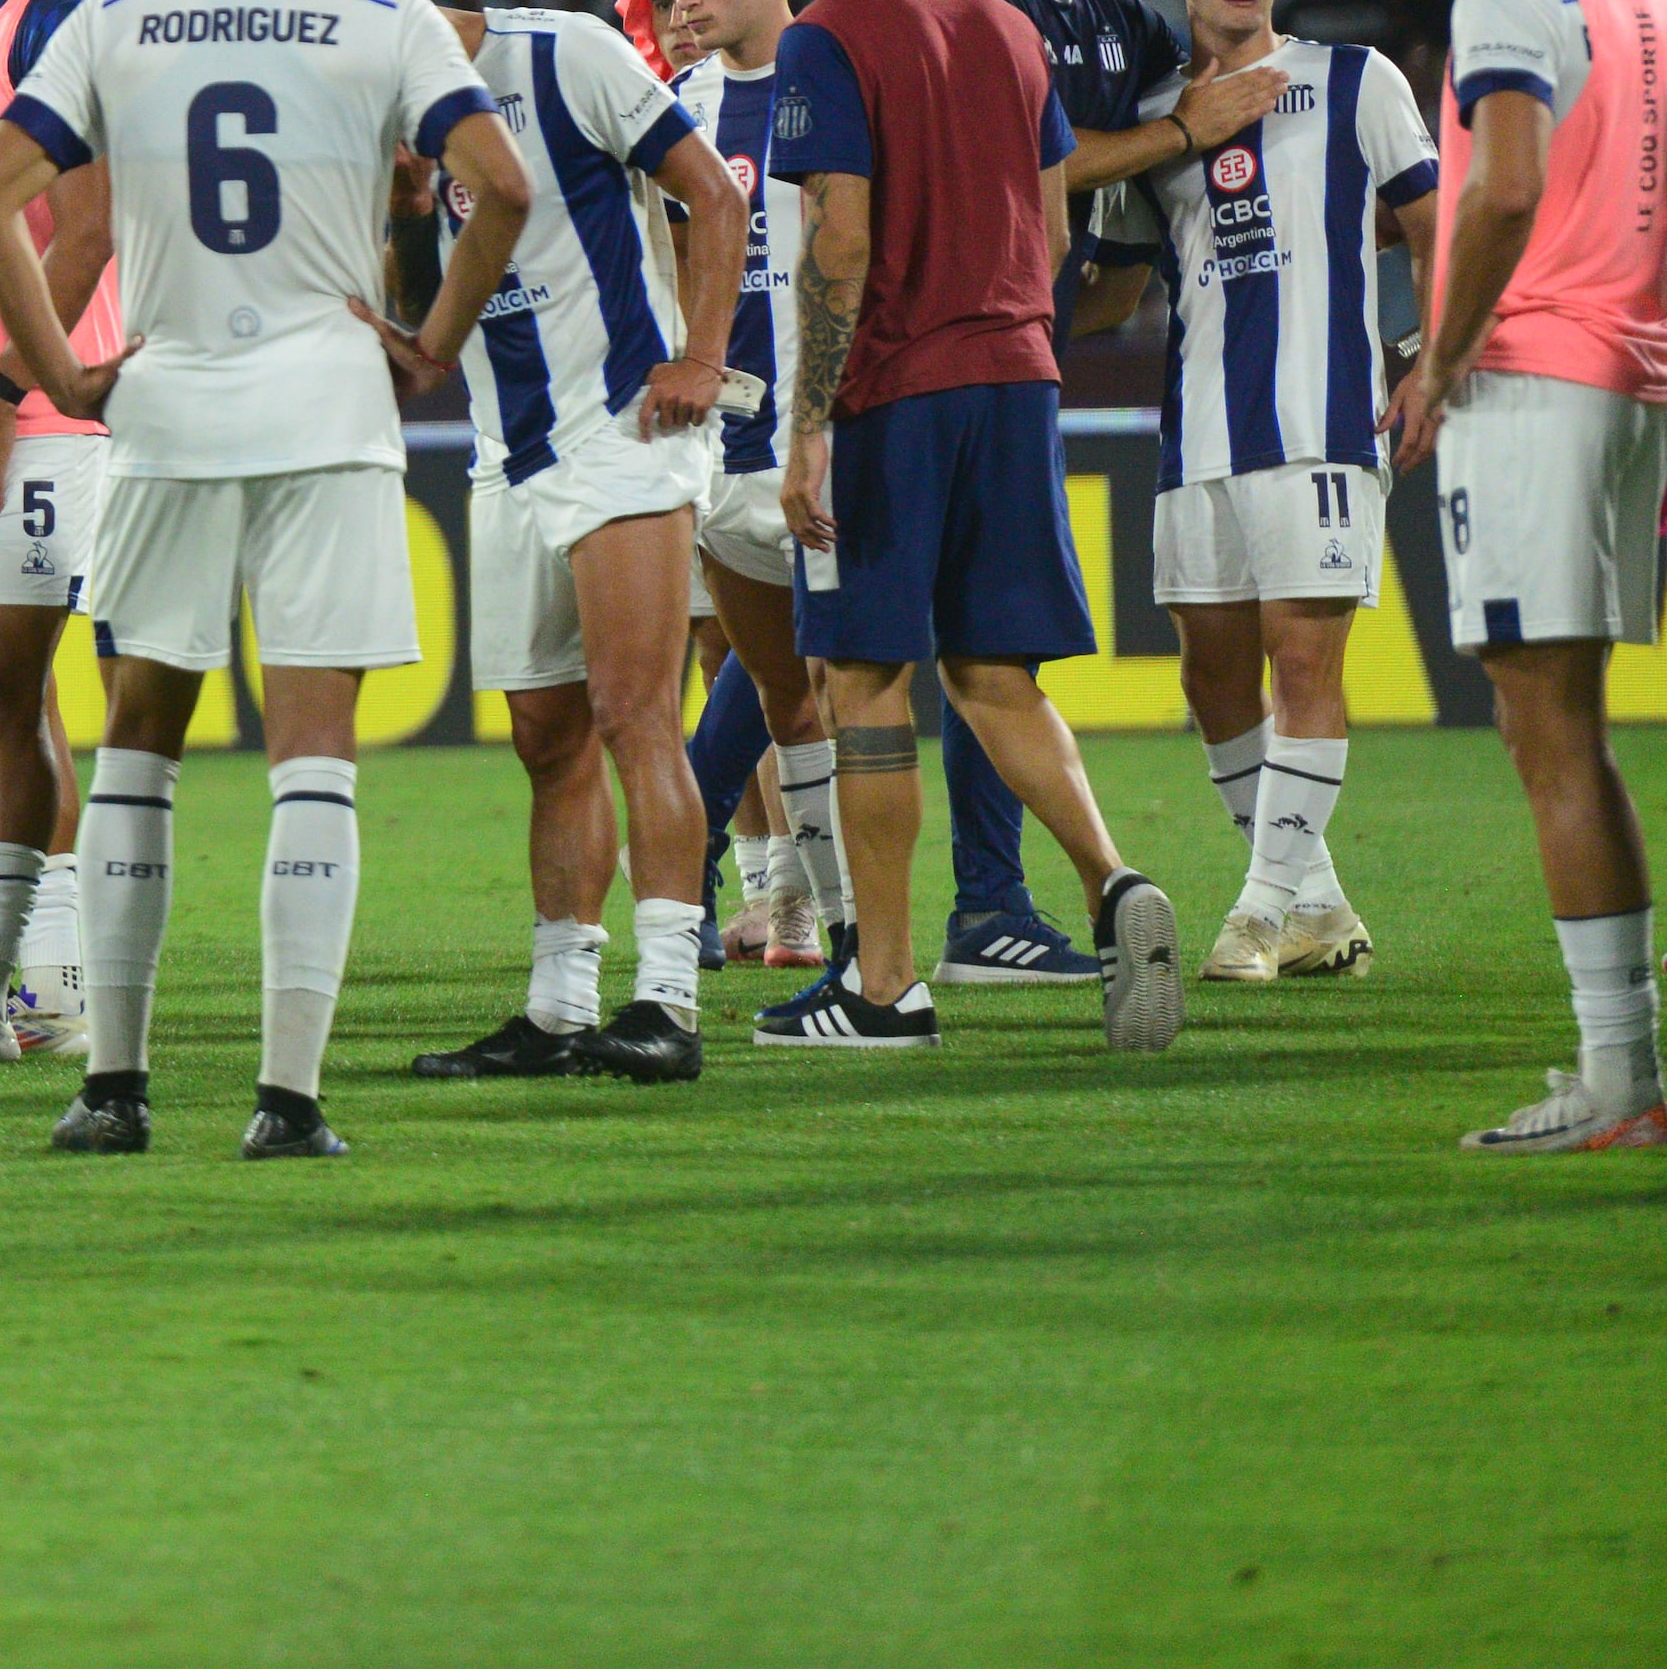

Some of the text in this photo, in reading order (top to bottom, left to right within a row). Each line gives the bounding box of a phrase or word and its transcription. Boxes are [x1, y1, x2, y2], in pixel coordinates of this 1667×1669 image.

[138, 6, 340, 46] RODRIGUEZ
[187, 81, 281, 255] 6
[1210, 195, 1273, 229] ICBC
[1213, 225, 1276, 250] Argentina
[1218, 249, 1292, 279] HOLCIM
[743, 271, 790, 292] LCIM
[481, 284, 551, 315] OLCIM
[23, 481, 56, 538] 5
[1310, 472, 1351, 528] 11
